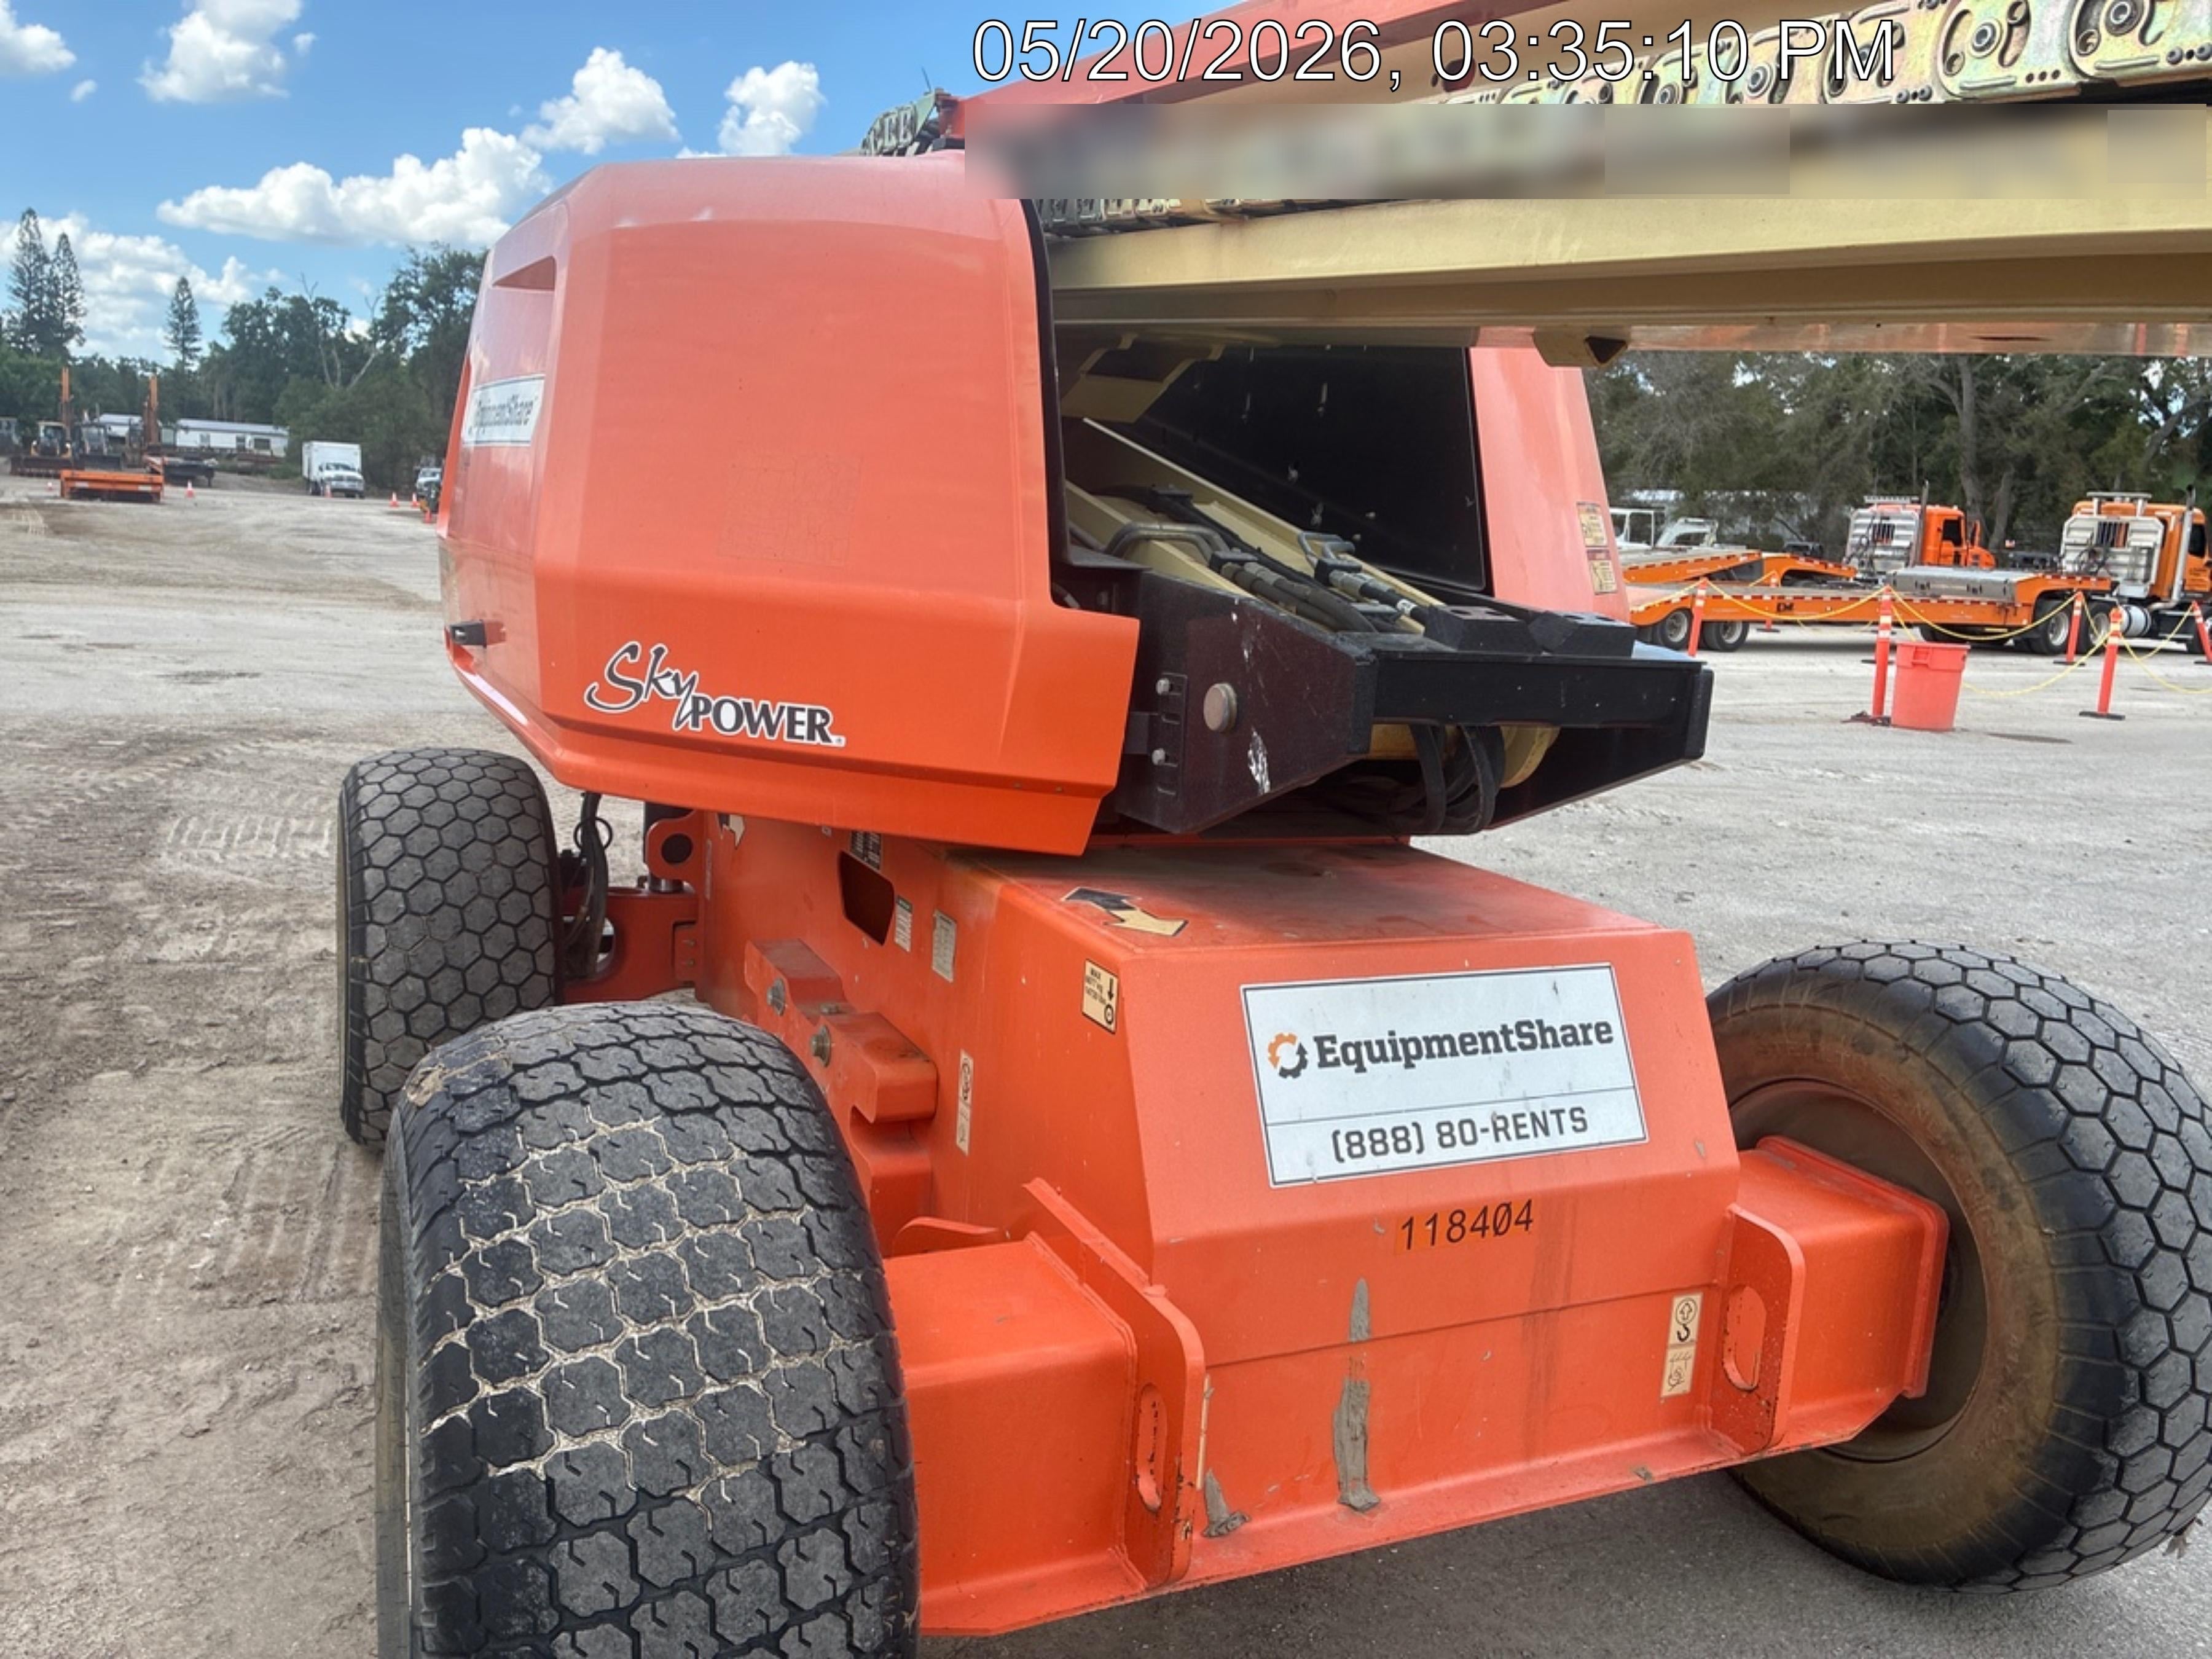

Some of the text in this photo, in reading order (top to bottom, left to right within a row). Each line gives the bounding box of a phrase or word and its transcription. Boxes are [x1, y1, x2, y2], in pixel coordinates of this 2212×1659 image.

[1314, 1019, 1614, 1073] EquipmentShare
[1332, 1107, 1588, 1163] (888) 80-RENTS
[1400, 1199, 1534, 1250] 118404
